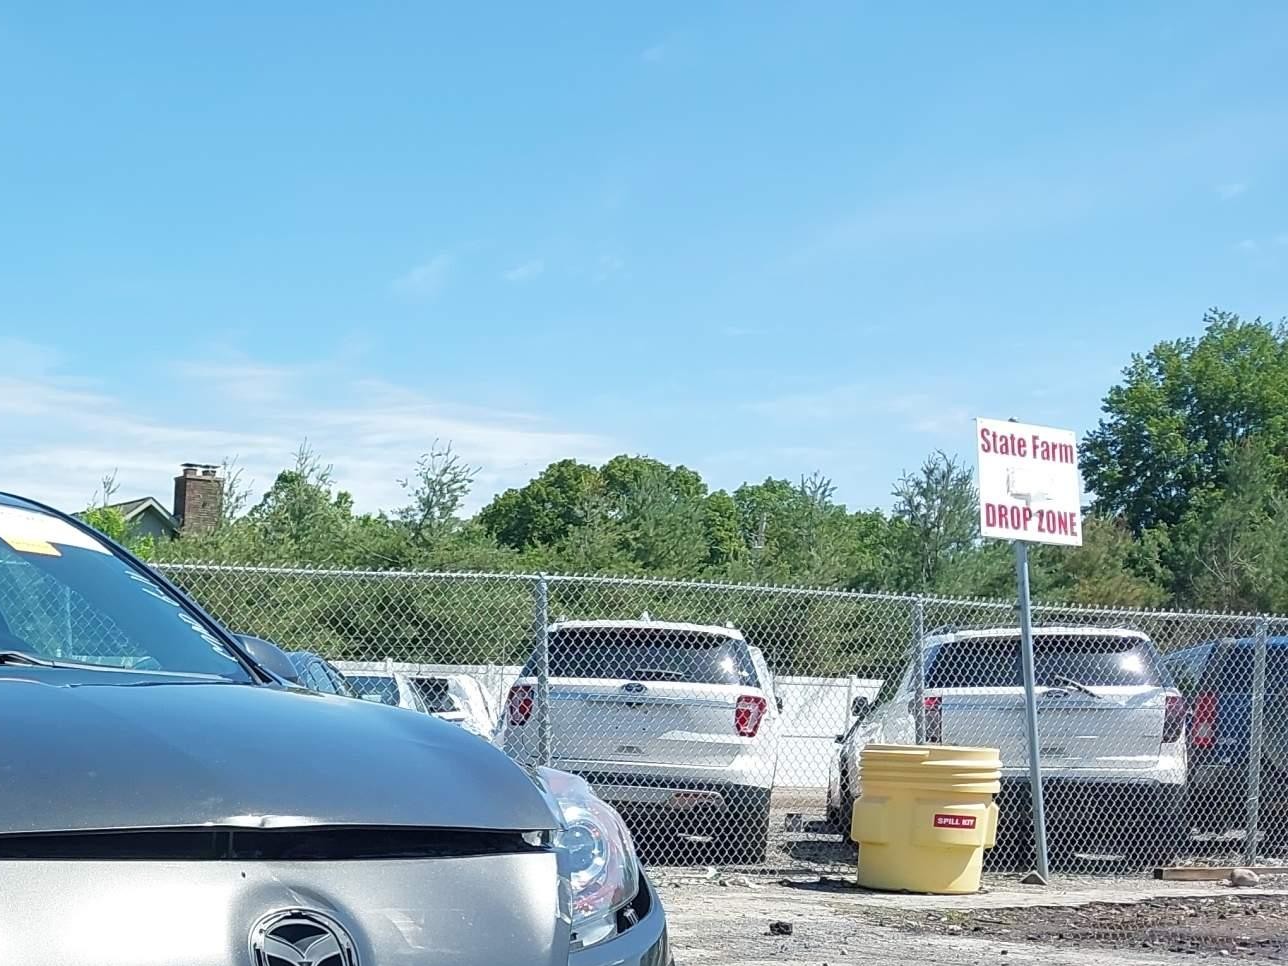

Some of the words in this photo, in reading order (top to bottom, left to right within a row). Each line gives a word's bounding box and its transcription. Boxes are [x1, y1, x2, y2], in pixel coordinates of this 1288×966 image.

[980, 428, 1027, 458] State
[1031, 435, 1074, 464] Farm
[985, 502, 1032, 531] DROP
[1037, 508, 1078, 537] ZONE
[937, 817, 961, 826] SPILL
[962, 818, 975, 826] KIT
